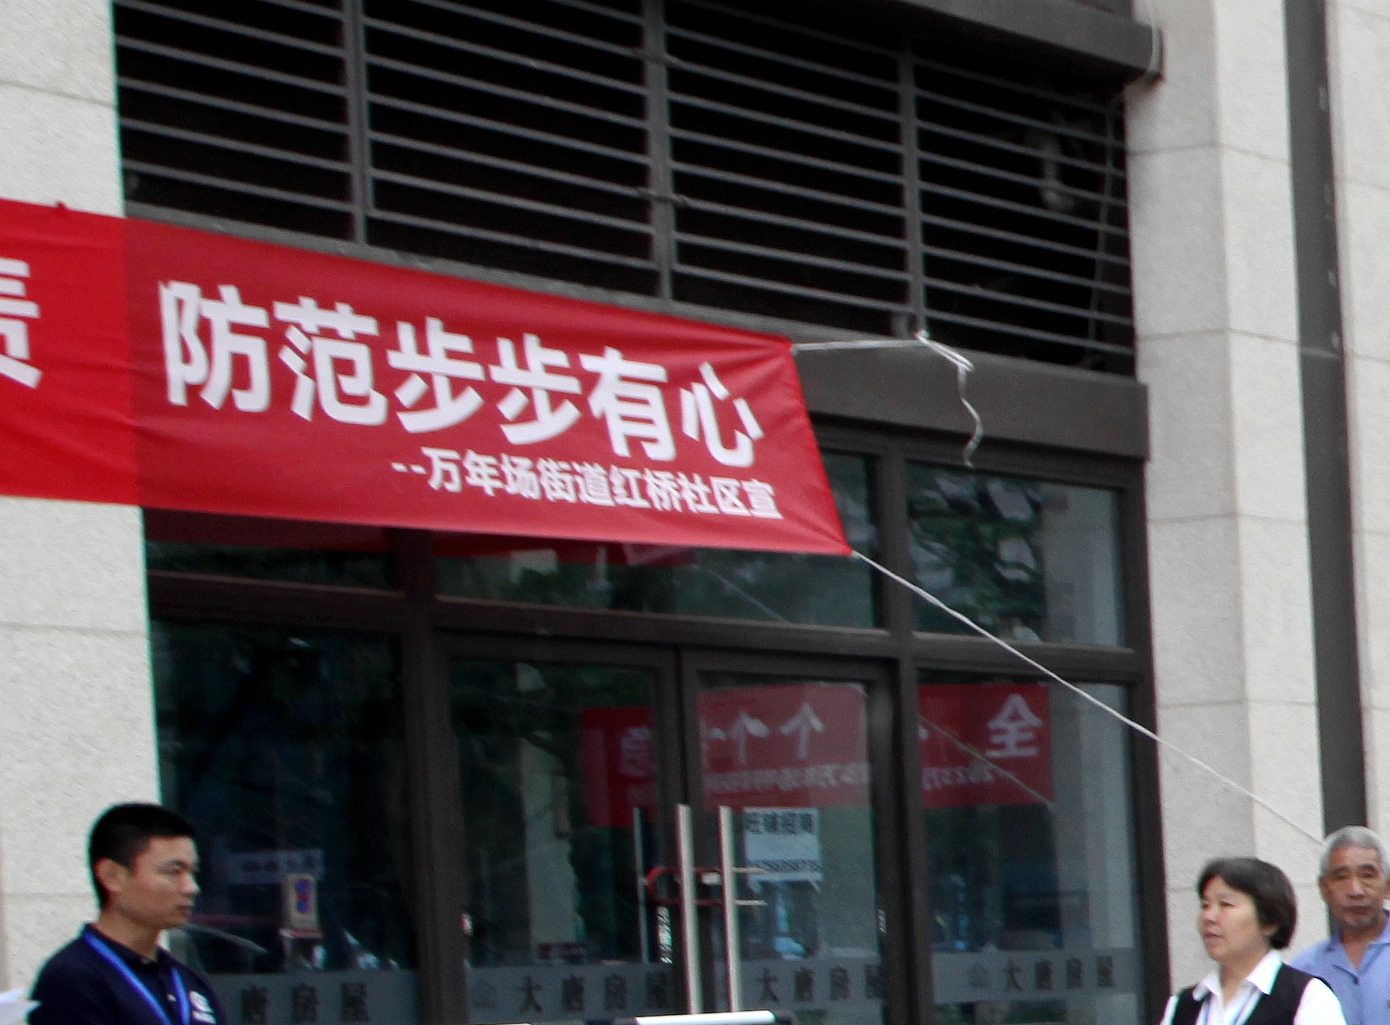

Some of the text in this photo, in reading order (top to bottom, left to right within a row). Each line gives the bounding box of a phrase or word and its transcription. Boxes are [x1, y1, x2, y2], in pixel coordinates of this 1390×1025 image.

[158, 279, 763, 469] 防范步步有心
[391, 446, 784, 519] --万年场街道红桥社区宣
